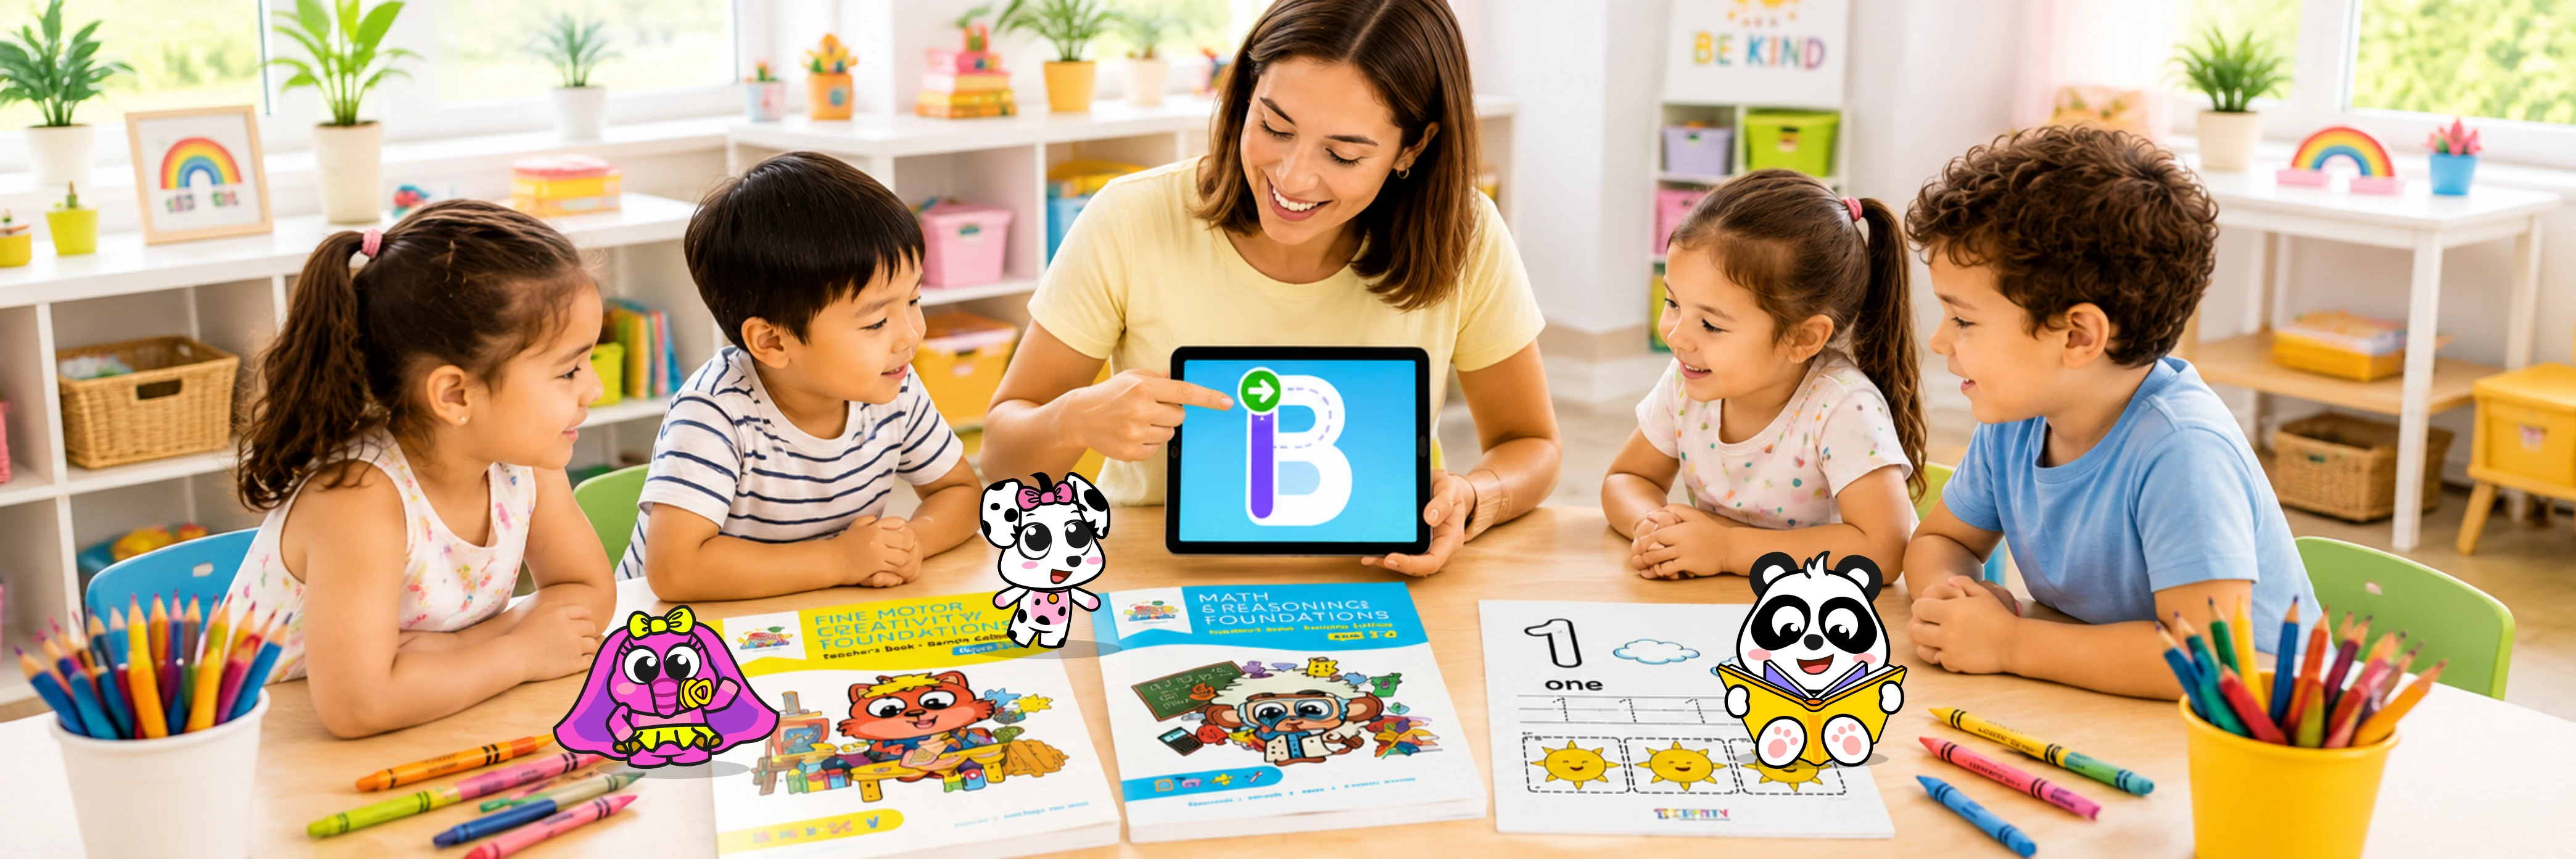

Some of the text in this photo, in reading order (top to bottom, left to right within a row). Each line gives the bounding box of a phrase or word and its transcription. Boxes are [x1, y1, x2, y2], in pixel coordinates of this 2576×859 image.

[1693, 31, 1826, 69] BE KIND
[1245, 375, 1352, 526] B
[1199, 592, 1268, 603] MATH
[815, 602, 963, 626] FINE MOTOR
[1204, 610, 1390, 625] FOUNDATIONS
[885, 644, 915, 652] Book
[1524, 618, 1582, 668] 1
[1545, 680, 1603, 691] one
